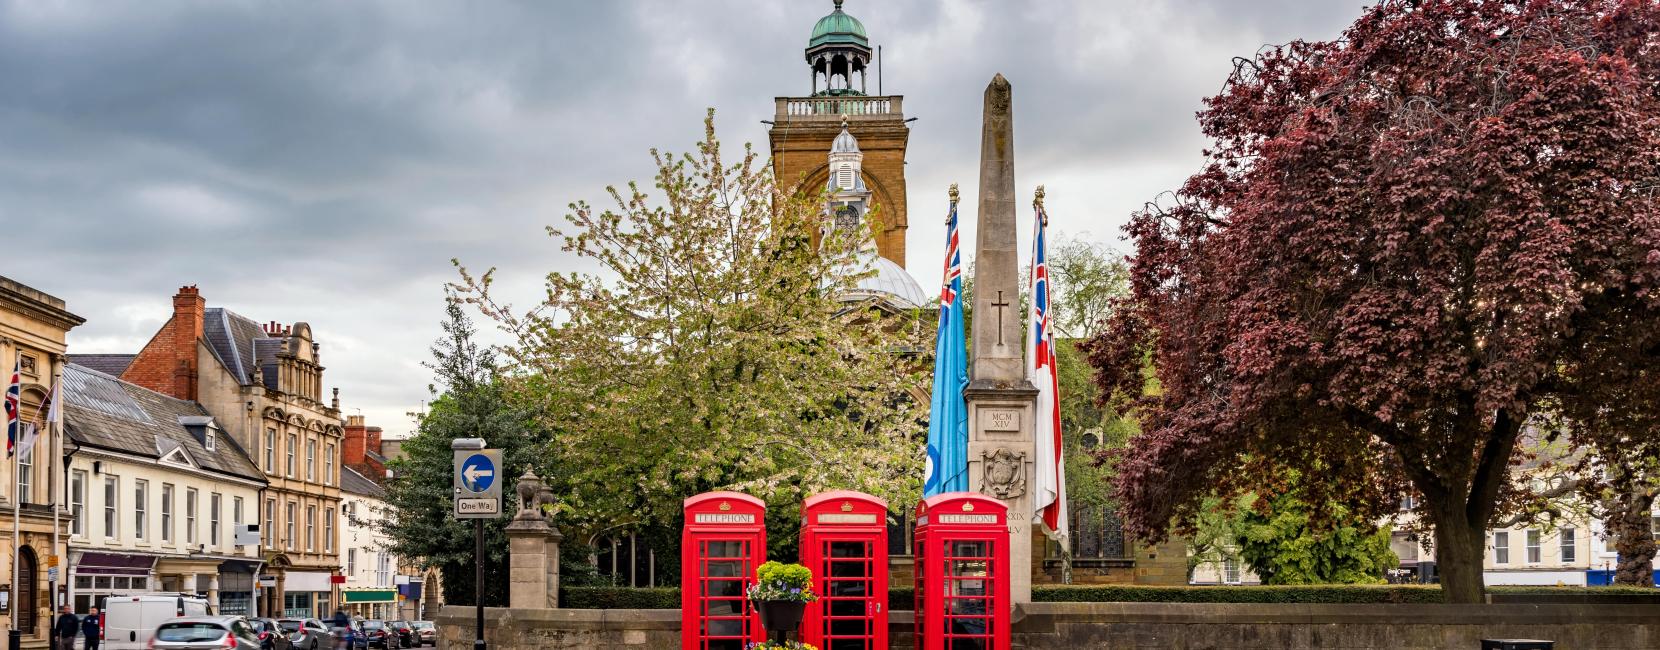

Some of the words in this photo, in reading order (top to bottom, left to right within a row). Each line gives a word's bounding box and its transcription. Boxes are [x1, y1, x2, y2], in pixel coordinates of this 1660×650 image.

[992, 412, 1012, 420] MCM
[994, 420, 1010, 428] XIV
[478, 503, 494, 511] Way
[698, 514, 753, 523] TELEPHONE
[942, 515, 995, 523] TELEPHONE
